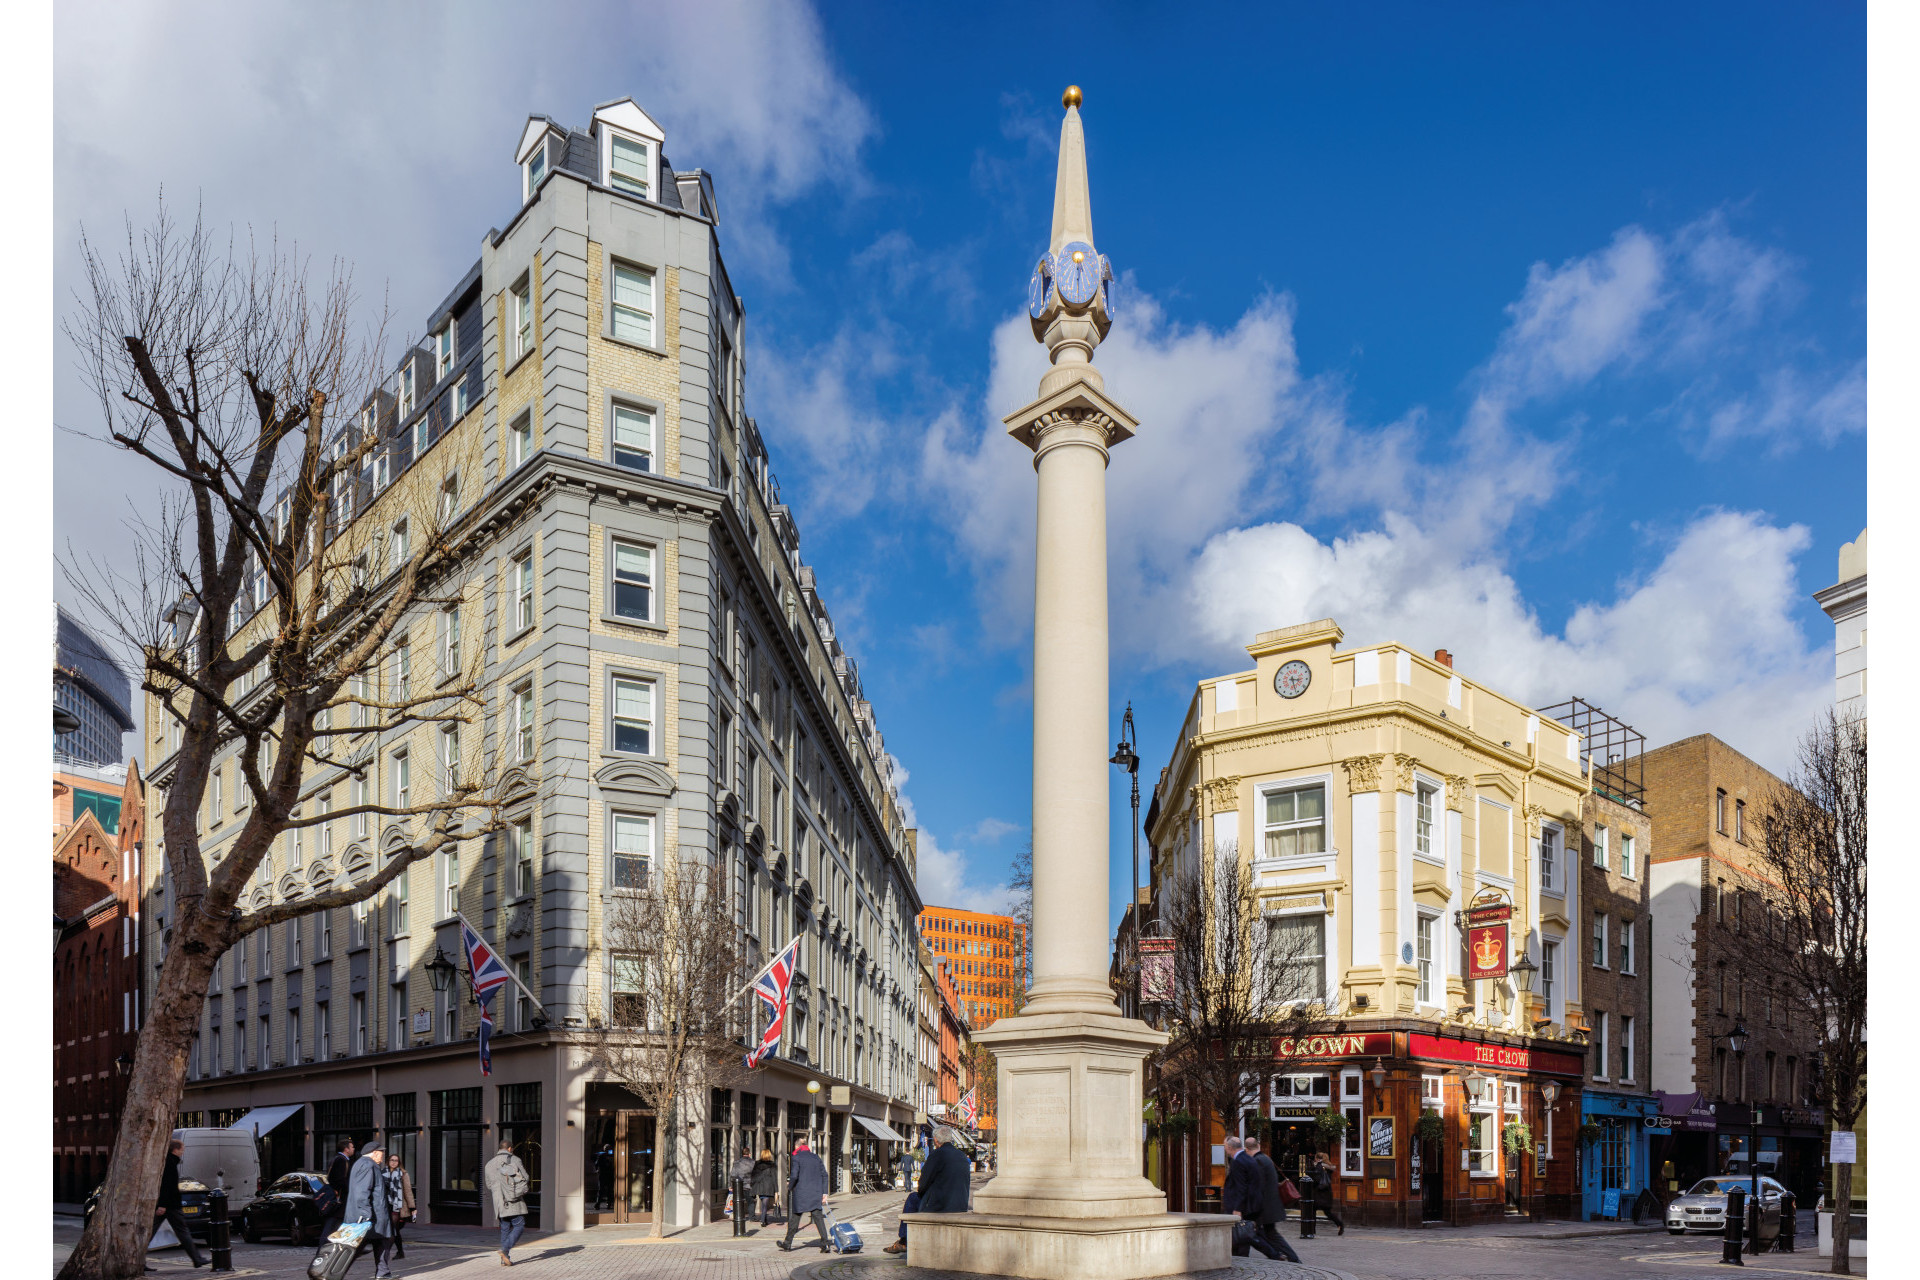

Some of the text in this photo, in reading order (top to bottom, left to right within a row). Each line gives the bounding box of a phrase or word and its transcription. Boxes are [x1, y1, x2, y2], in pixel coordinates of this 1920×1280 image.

[1473, 910, 1508, 920] THE CROWN
[1483, 969, 1505, 977] CROWN
[1280, 1036, 1366, 1056] CROWN
[1475, 1046, 1495, 1063] THE
[1497, 1050, 1532, 1067] CROWN
[1280, 1108, 1325, 1116] ENTRANCE
